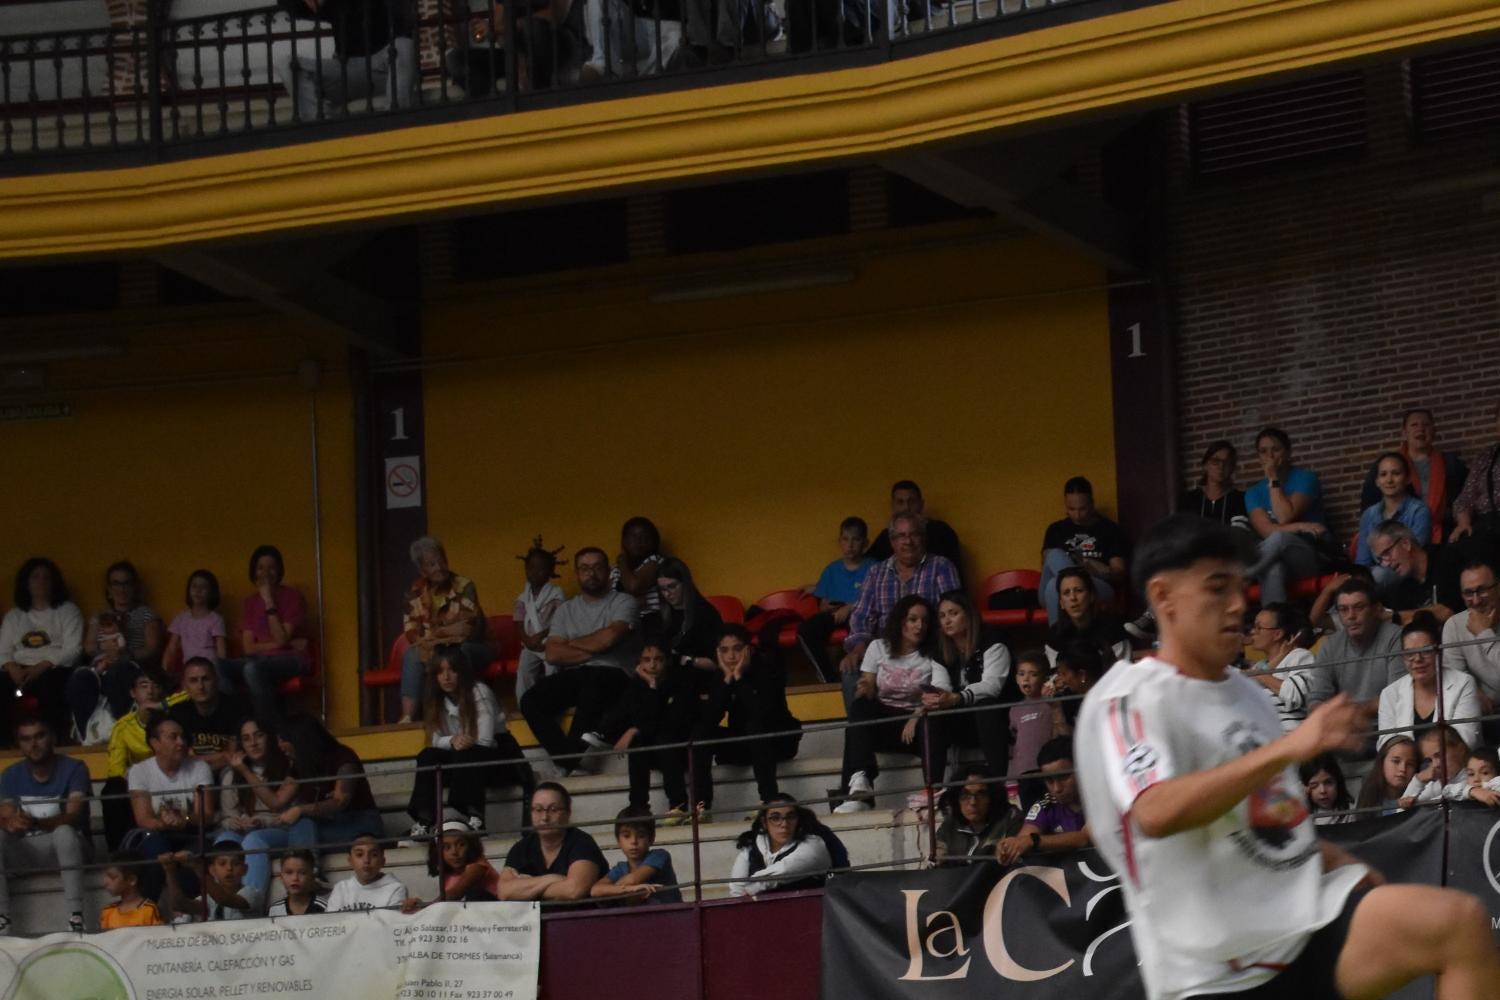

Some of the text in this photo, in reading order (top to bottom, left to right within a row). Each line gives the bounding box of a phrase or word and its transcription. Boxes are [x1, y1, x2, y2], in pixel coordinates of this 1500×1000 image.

[1127, 322, 1147, 358] 1
[391, 407, 409, 440] 1
[278, 954, 296, 967] GAS
[431, 951, 444, 960] DE
[447, 952, 481, 961] TORMES
[257, 979, 313, 994] RENOVABLES
